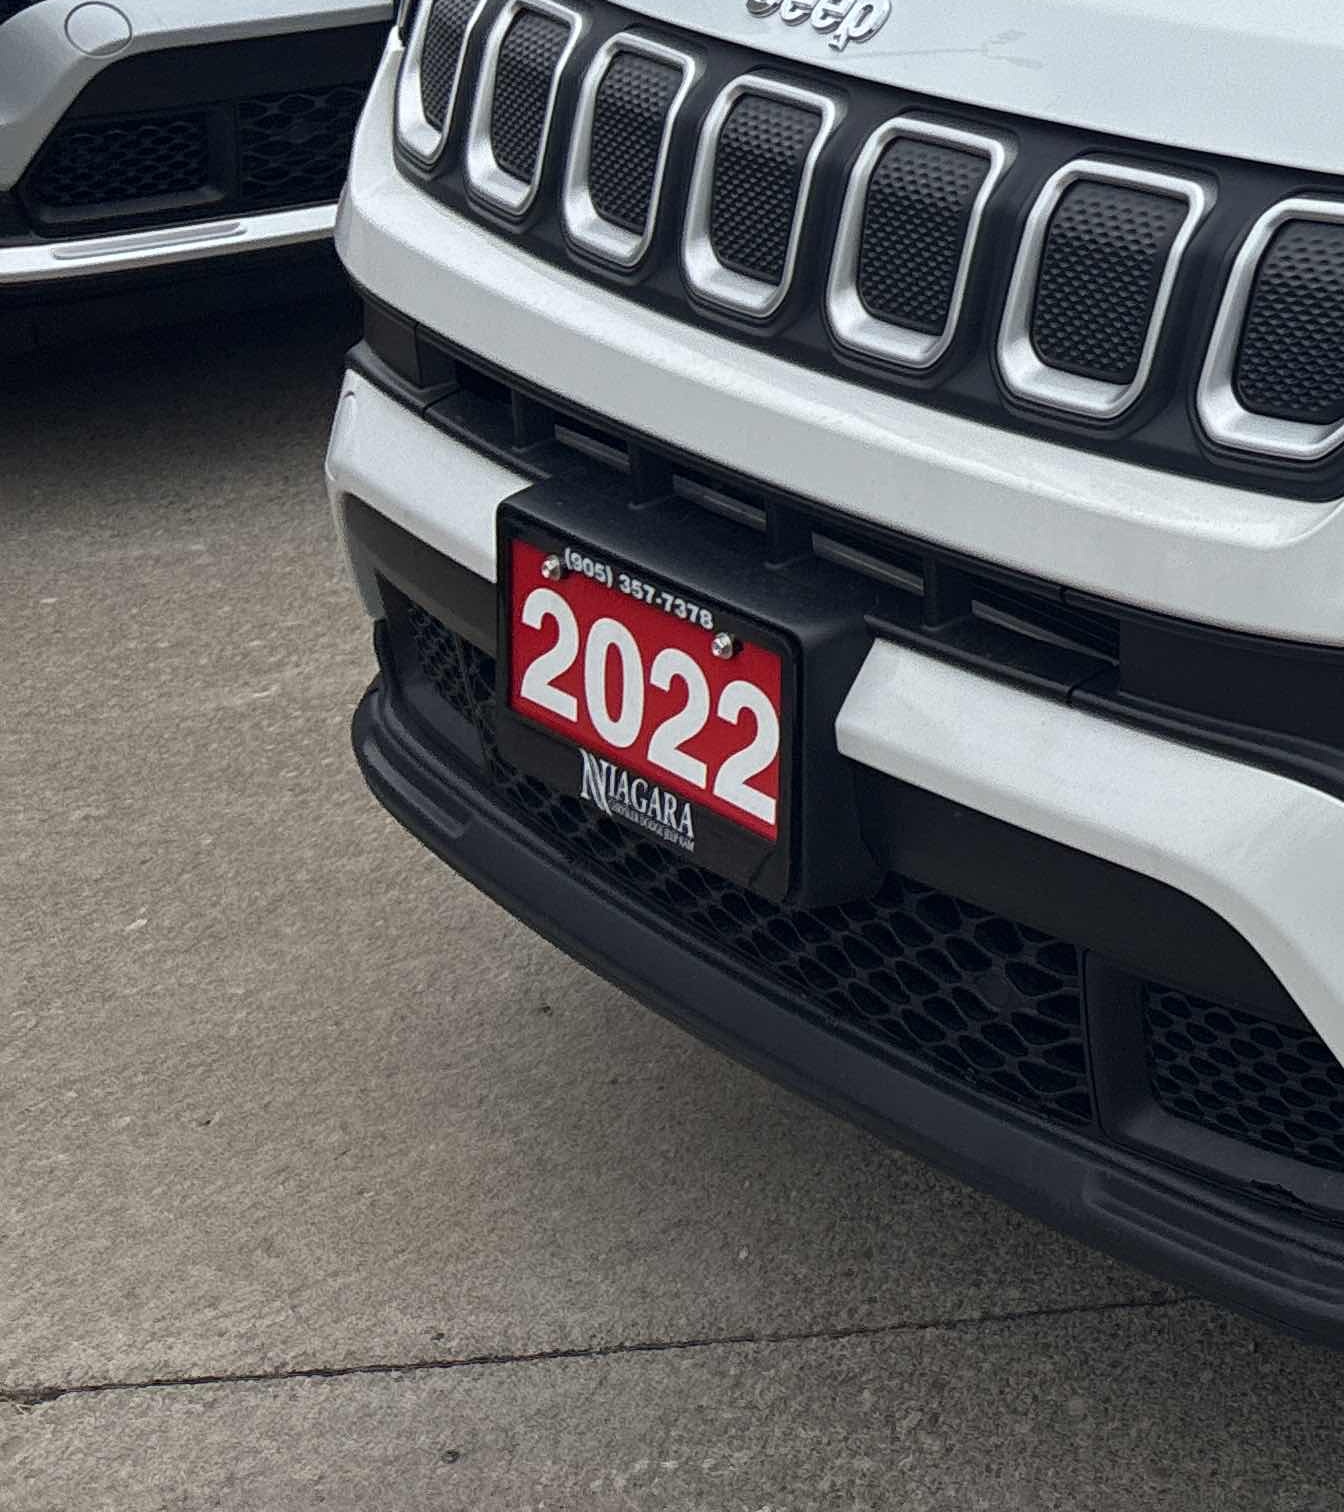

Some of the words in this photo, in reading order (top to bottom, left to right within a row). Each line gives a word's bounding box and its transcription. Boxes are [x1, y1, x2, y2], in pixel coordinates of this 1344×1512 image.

[564, 547, 614, 588] (905)
[520, 587, 780, 826] 2022
[579, 748, 695, 838] NIAGARA
